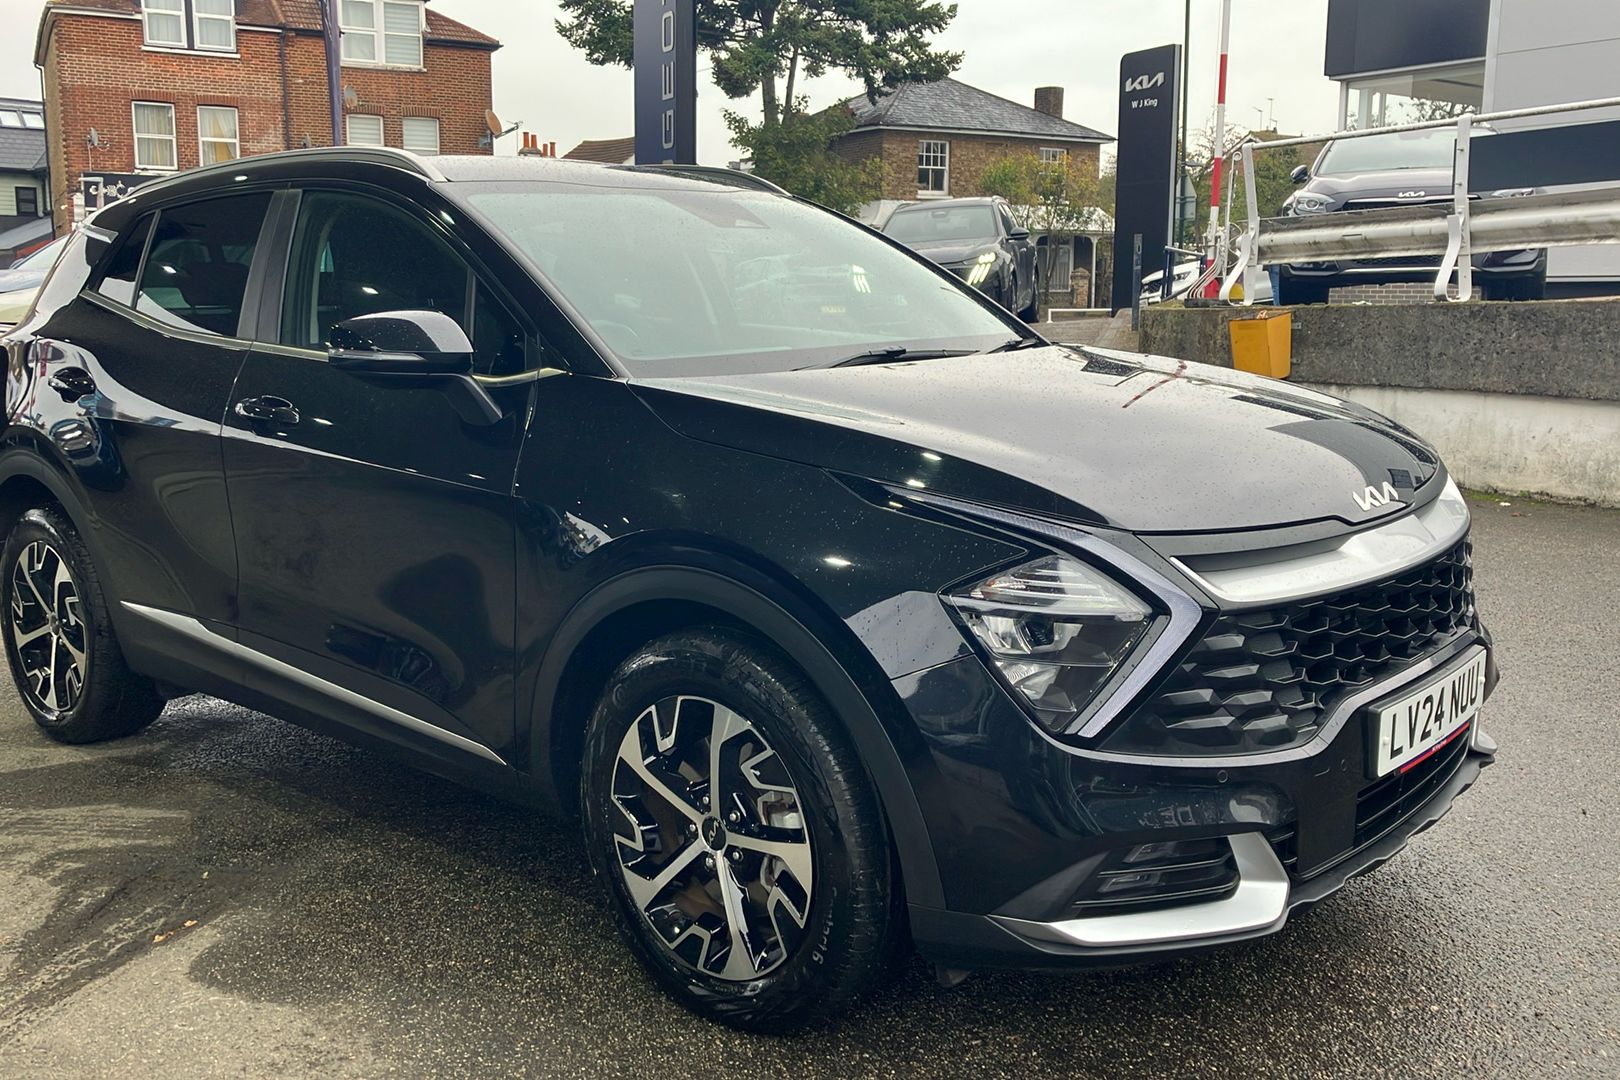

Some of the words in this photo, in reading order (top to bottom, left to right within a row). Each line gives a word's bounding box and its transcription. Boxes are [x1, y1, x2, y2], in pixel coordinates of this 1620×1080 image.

[1131, 100, 1139, 109] W
[1143, 98, 1158, 108] King
[1390, 686, 1445, 760] LV24
[1449, 661, 1480, 723] NUU
